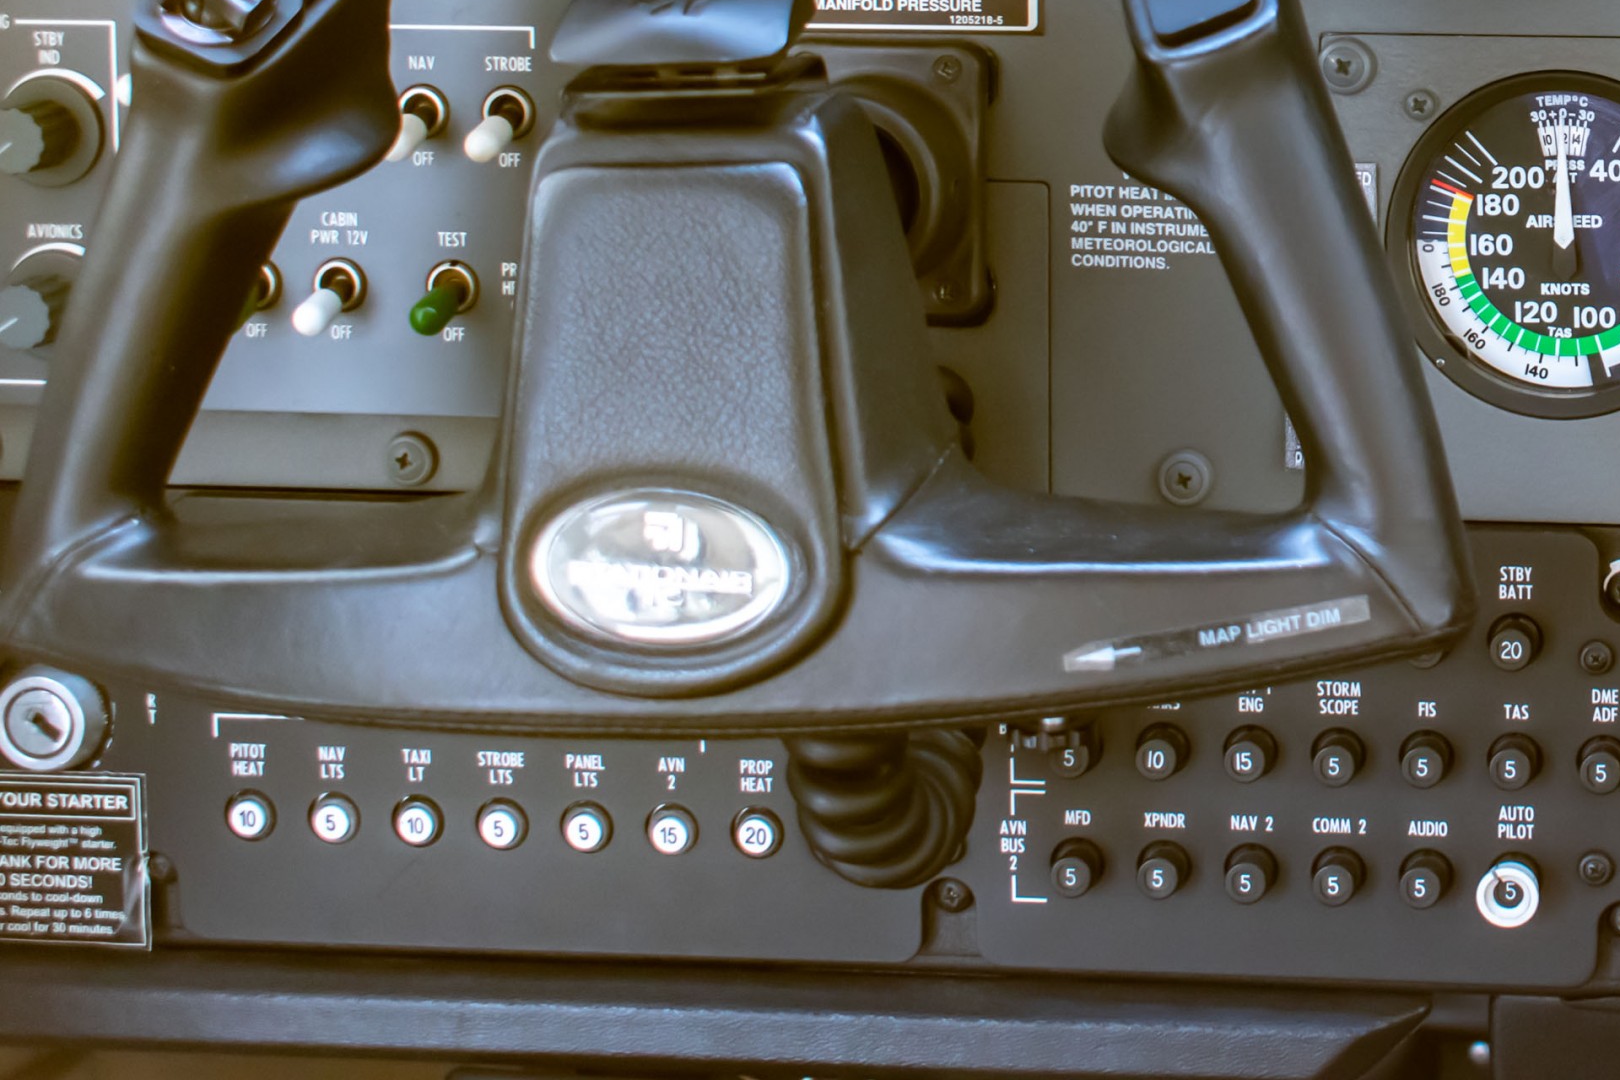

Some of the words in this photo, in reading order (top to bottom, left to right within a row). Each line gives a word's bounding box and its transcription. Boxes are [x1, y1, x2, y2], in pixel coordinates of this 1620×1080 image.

[485, 56, 532, 72] STROBE
[1492, 167, 1544, 189] 200
[322, 212, 357, 227] CABIN
[311, 230, 339, 245] PWR
[346, 230, 367, 245] 12V
[1072, 254, 1169, 270] CONDITIONS.
[1541, 284, 1590, 295] KNOTS
[1573, 308, 1616, 327] 100
[1199, 626, 1241, 647] MAP
[1246, 615, 1301, 638] LIGHT
[1305, 608, 1341, 629] DIM
[1317, 681, 1361, 698] STORM
[1319, 698, 1358, 715] SCOPE
[230, 743, 265, 758] PITOT
[233, 761, 264, 776] HEAT
[47, 794, 128, 809] STARTER
[1144, 812, 1185, 828] XPNDR
[1499, 806, 1534, 822] AUTO
[746, 827, 766, 845] 20
[1498, 823, 1534, 839] PILOT
[11, 874, 93, 889] SECONDS!
